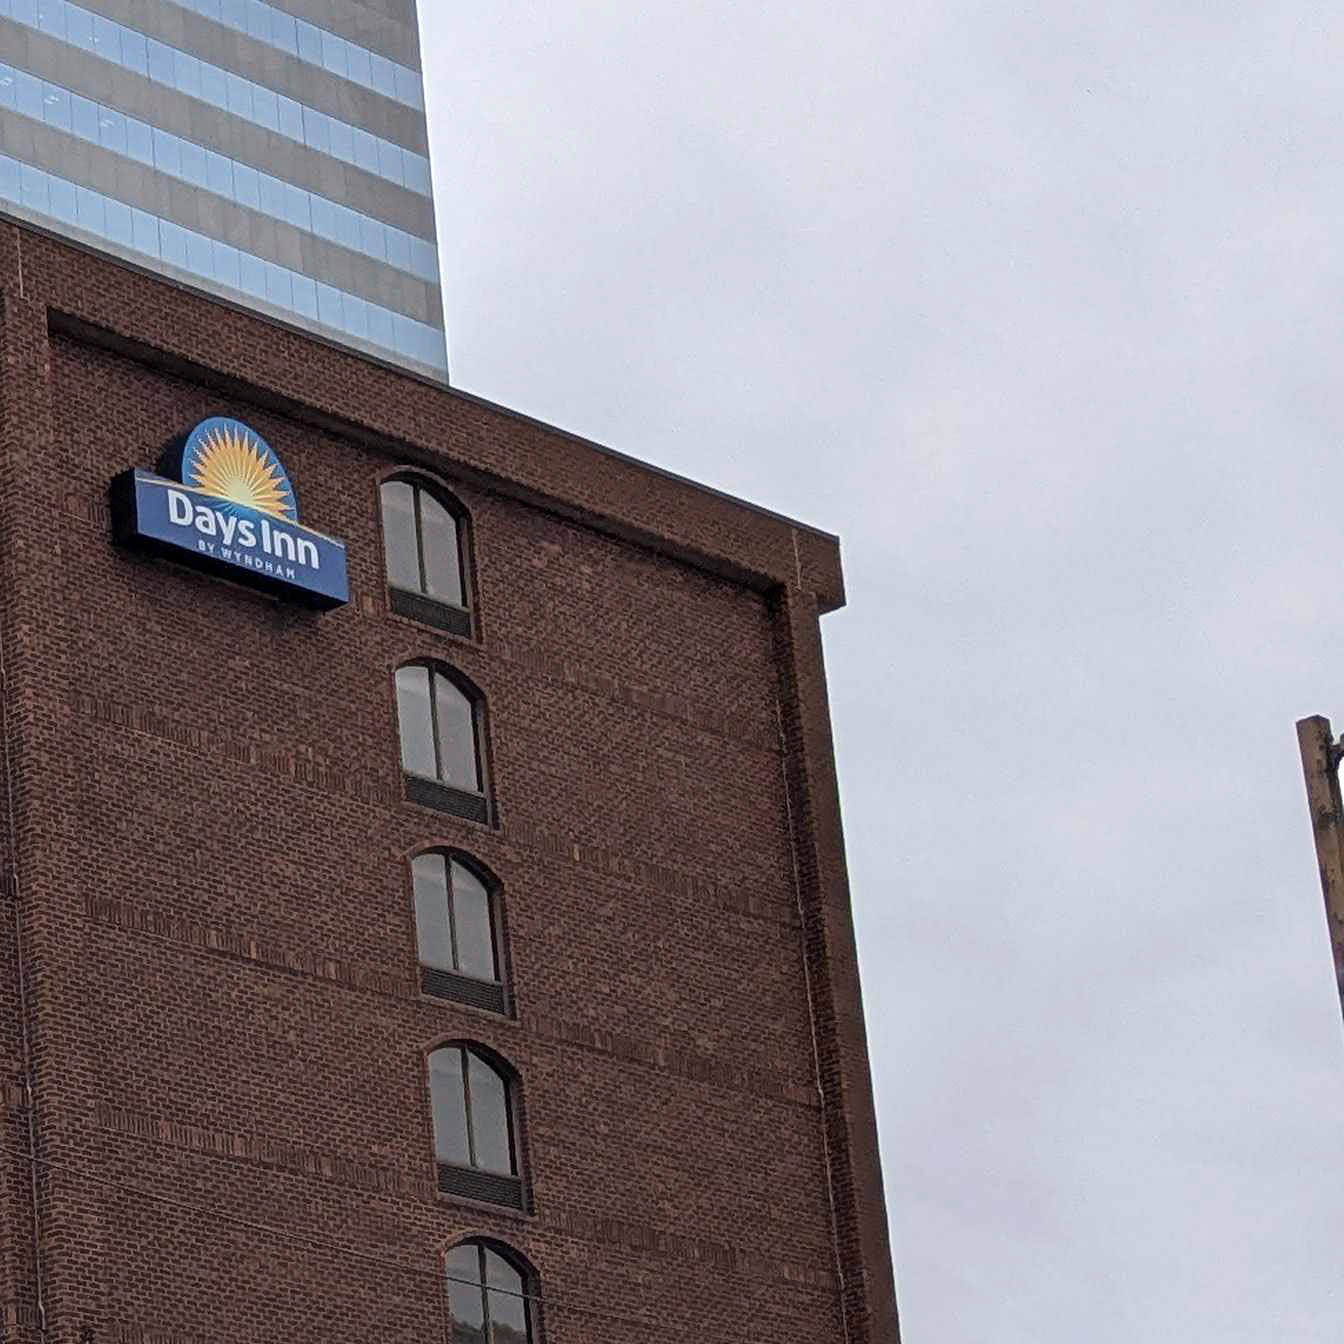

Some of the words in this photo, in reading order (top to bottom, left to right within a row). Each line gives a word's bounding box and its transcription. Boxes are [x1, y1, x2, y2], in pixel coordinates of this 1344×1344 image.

[167, 489, 257, 547] Days
[261, 519, 320, 570] Inn
[197, 539, 215, 554] BY
[220, 548, 296, 580] WYNDHAM
